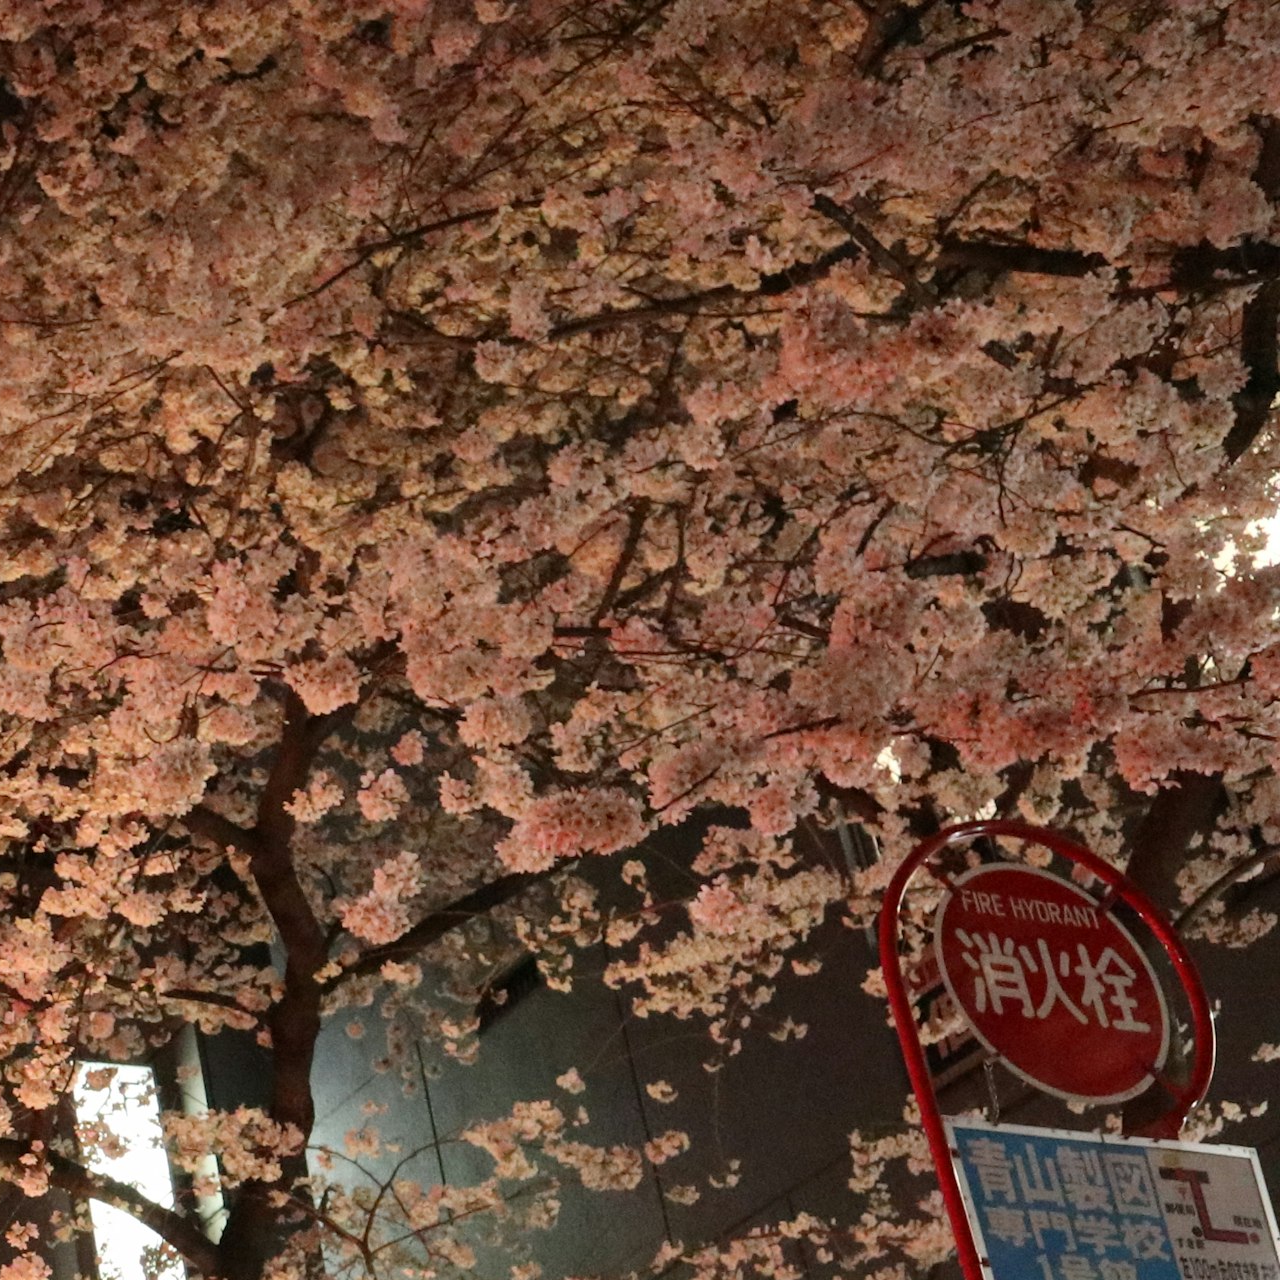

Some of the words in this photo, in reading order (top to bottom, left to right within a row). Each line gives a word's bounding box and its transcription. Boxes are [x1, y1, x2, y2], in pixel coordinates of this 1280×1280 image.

[962, 890, 1005, 916] FIRE
[1010, 896, 1100, 929] HYDRANT
[955, 928, 1151, 1033] 消火栓
[966, 1137, 1161, 1217] 青山製図
[983, 1206, 1170, 1261] 専門学校
